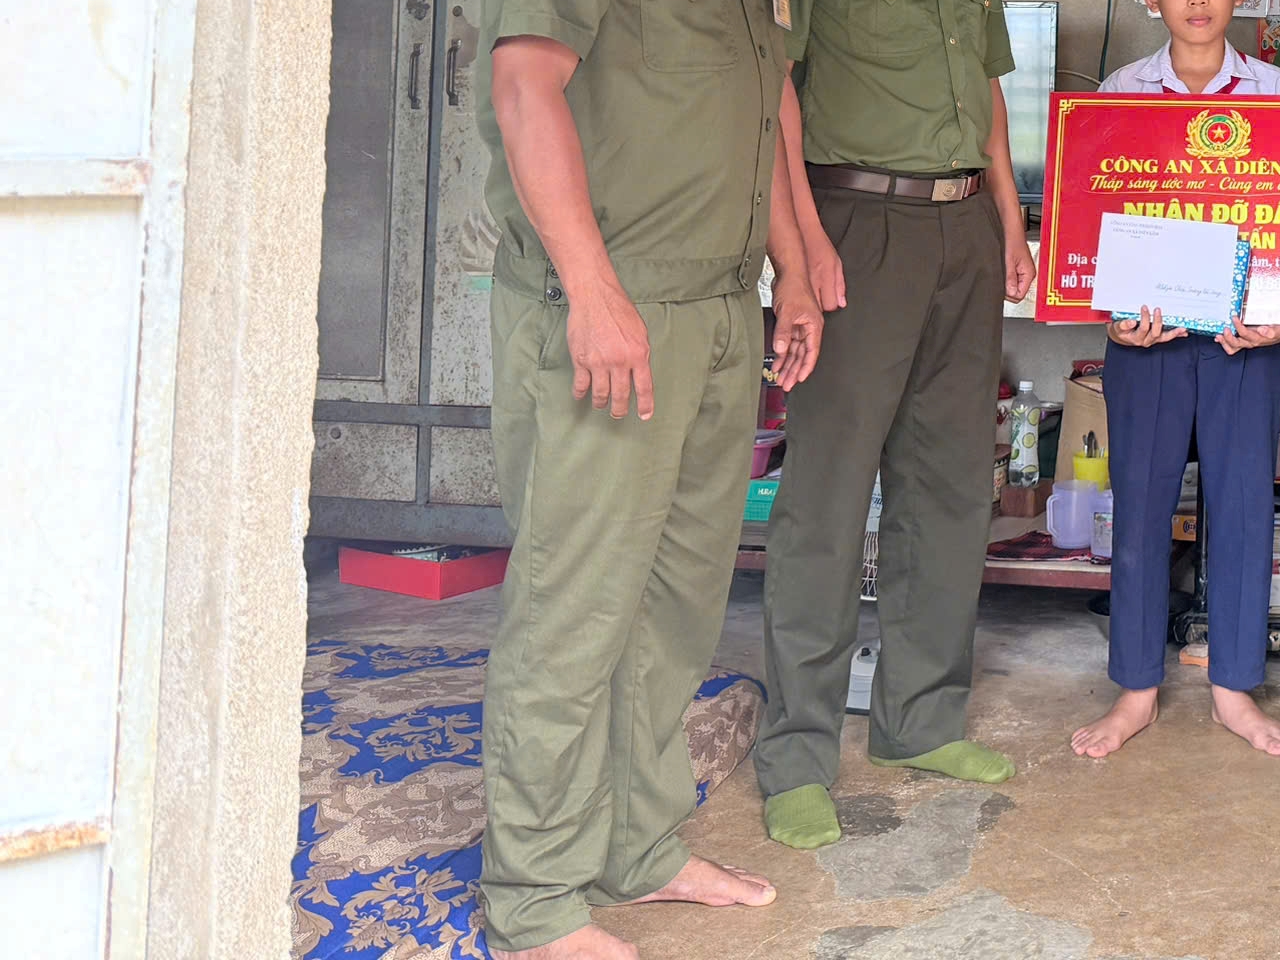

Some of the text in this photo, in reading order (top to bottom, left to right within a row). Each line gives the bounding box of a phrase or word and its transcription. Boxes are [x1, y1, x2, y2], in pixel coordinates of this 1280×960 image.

[1100, 156, 1158, 173] CÔNG
[1163, 159, 1193, 174] AN
[1199, 157, 1228, 174] XÃ
[1090, 174, 1123, 192] Thắp
[1127, 177, 1158, 192] sáng
[1161, 177, 1184, 189] ước
[1186, 179, 1206, 189] mơ
[1219, 176, 1252, 193] Cùng
[1255, 181, 1274, 191] em
[1211, 199, 1249, 224] ĐỠ
[1067, 252, 1088, 267] Địa
[1249, 255, 1273, 270] âm,
[1061, 270, 1078, 288] HỖ
[1080, 274, 1096, 288] TR
